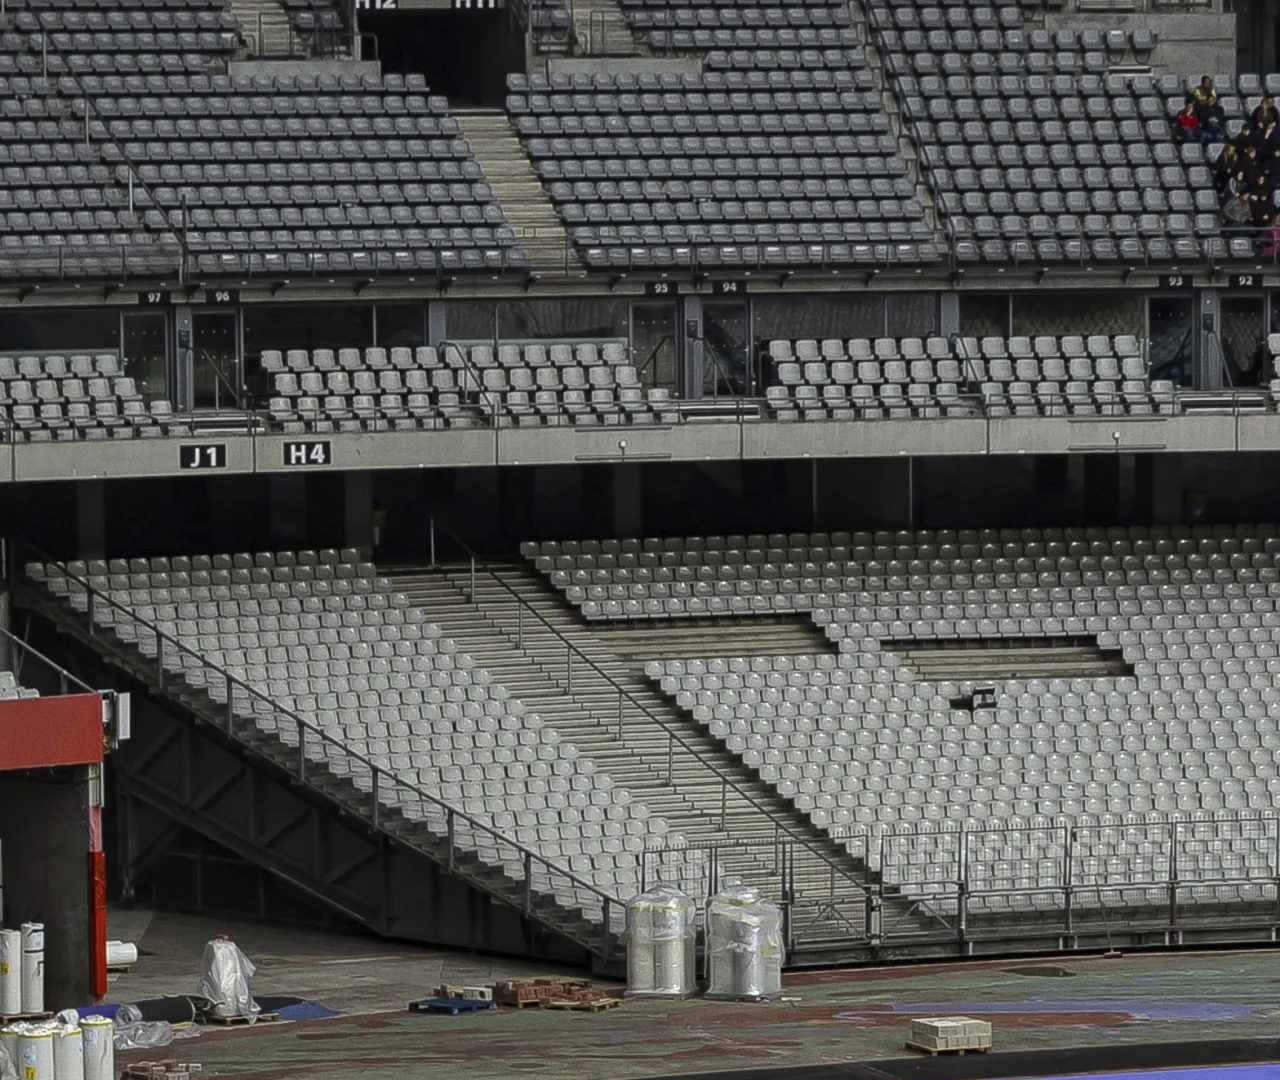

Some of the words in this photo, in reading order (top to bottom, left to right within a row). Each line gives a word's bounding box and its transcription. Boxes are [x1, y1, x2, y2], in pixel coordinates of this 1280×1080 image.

[1169, 276, 1183, 287] 93
[1238, 275, 1253, 286] 92
[654, 283, 668, 293] 95
[722, 281, 737, 292] 94
[148, 292, 161, 303] 97
[215, 291, 230, 302] 96
[190, 447, 217, 468] J1
[290, 443, 326, 464] H4
